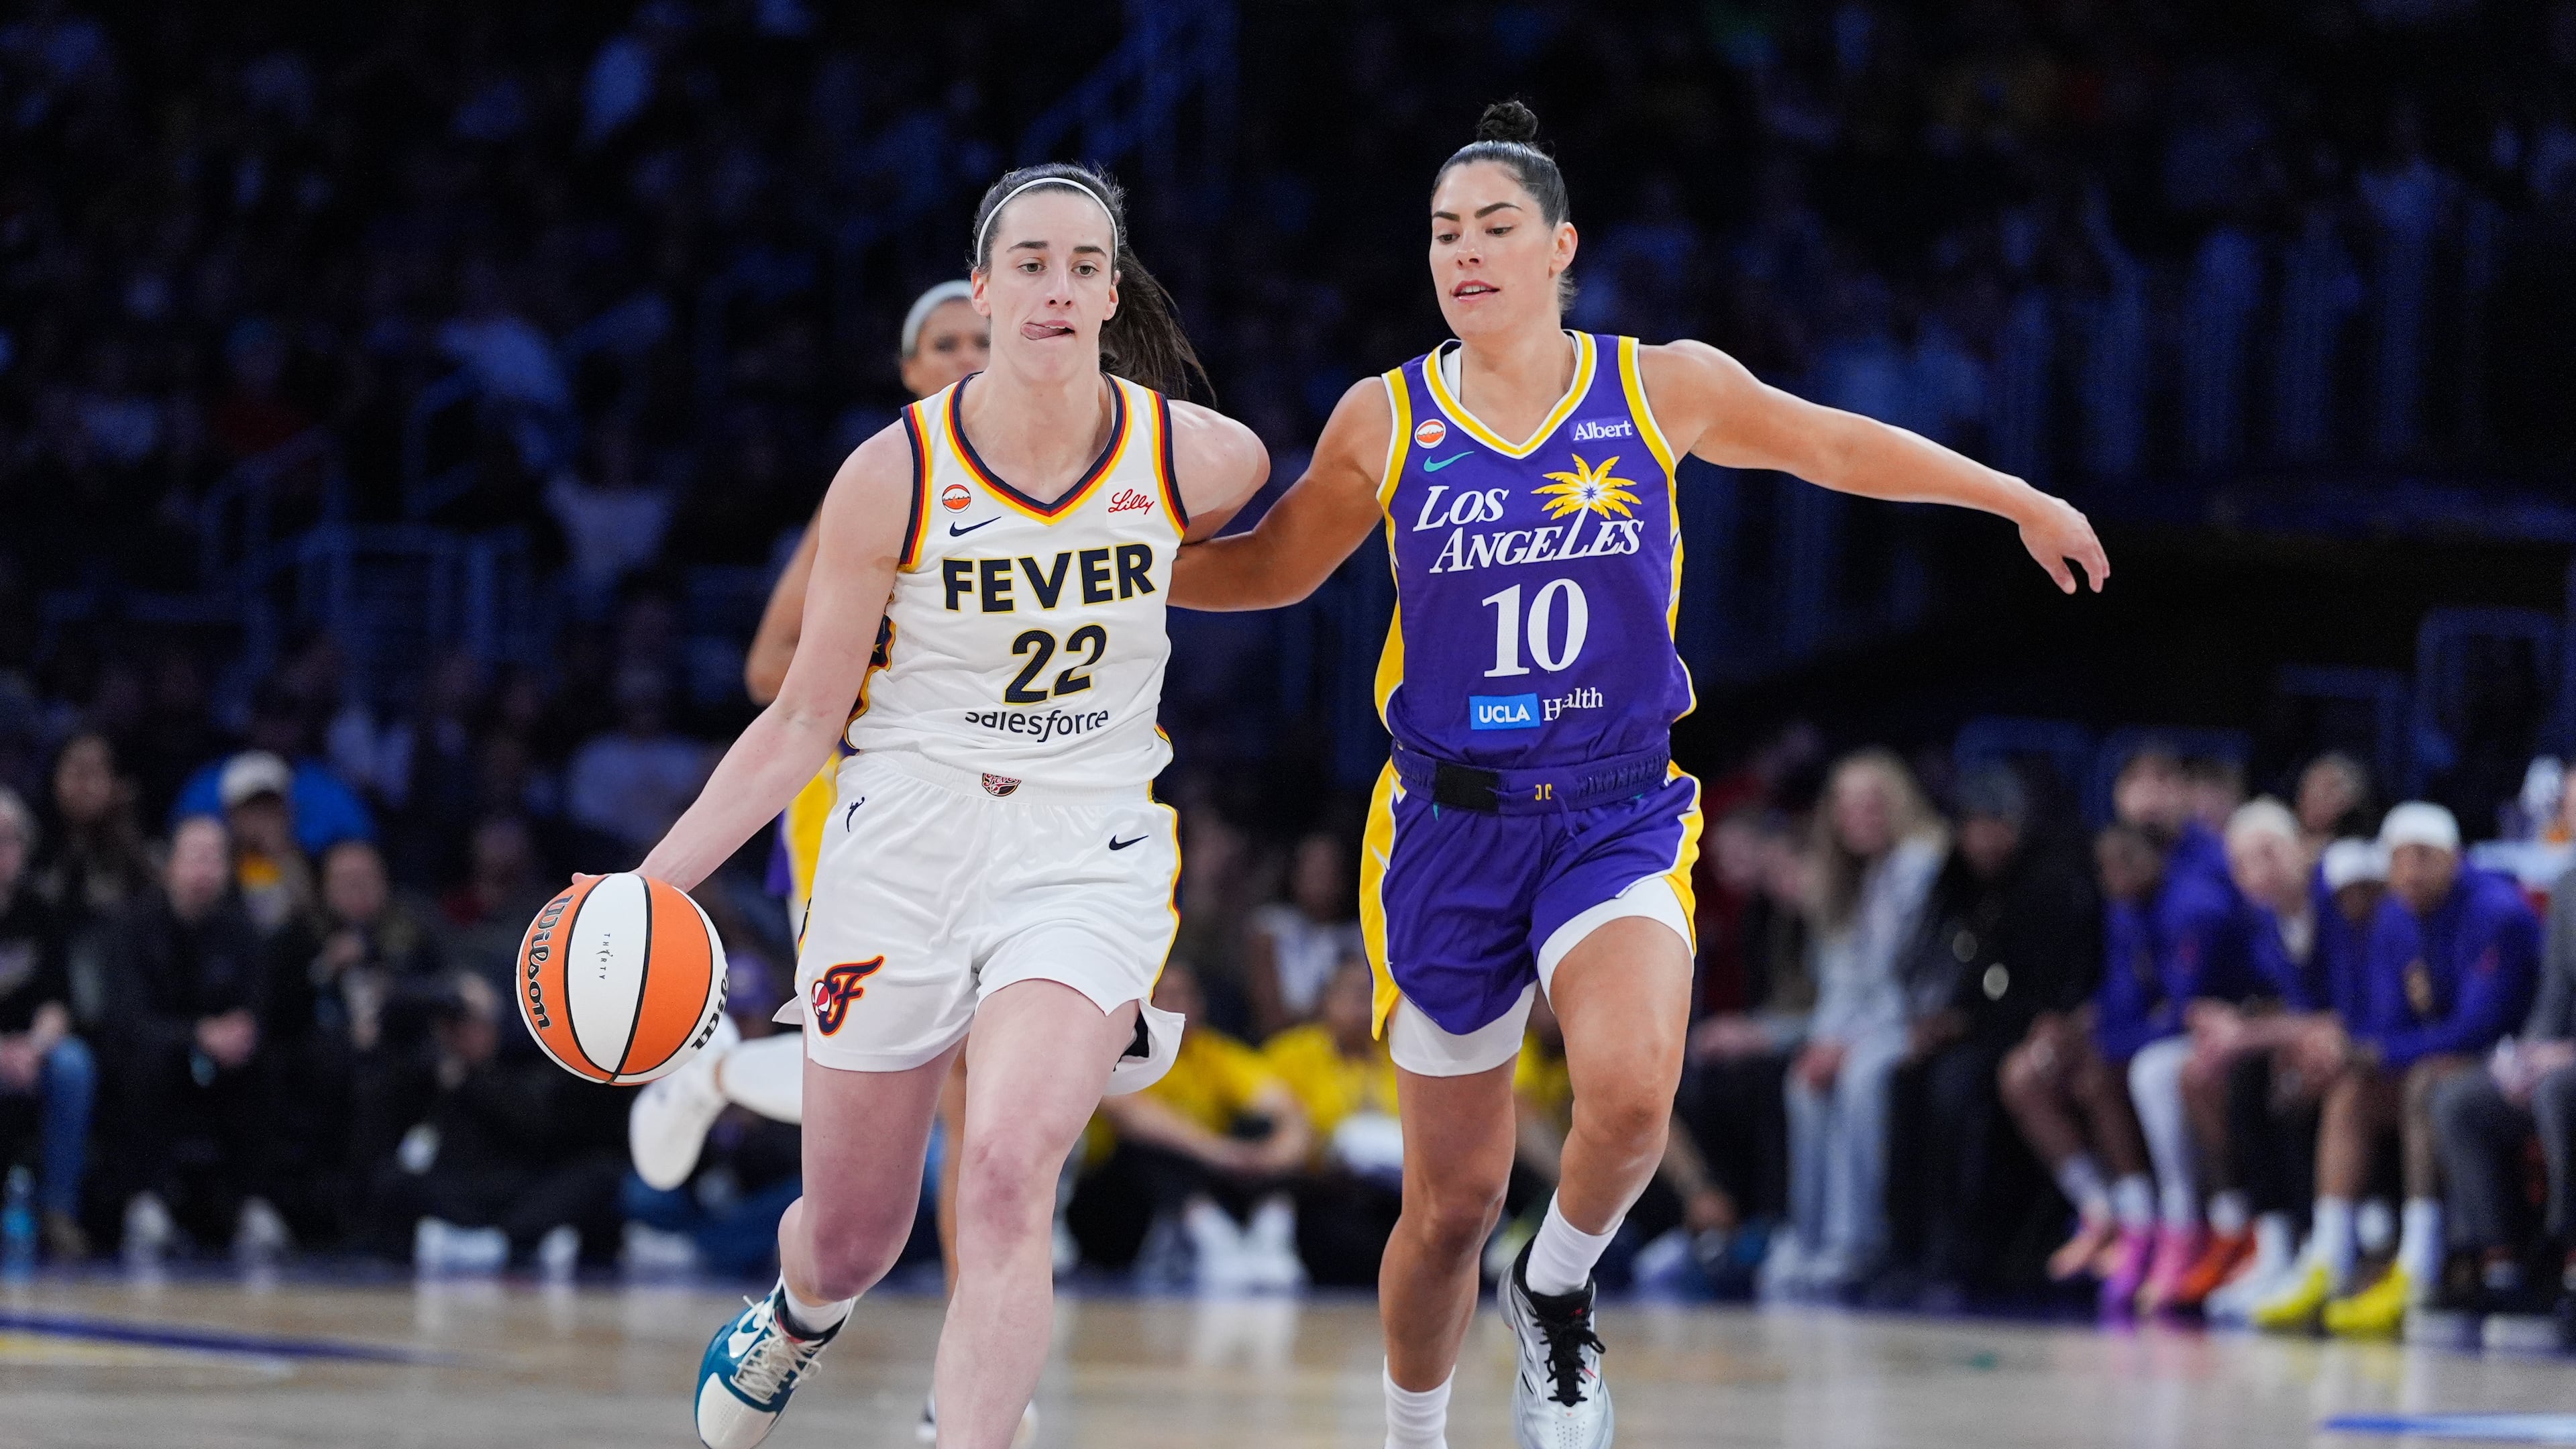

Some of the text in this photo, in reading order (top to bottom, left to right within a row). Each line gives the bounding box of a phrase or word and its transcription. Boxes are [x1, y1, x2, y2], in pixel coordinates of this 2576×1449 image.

[1573, 419, 1633, 441] Albert
[1108, 488, 1155, 515] Lilly
[941, 541, 1156, 614] FEVER
[1004, 622, 1108, 706] 22
[1481, 578, 1589, 678] 10
[1479, 686, 1604, 724] UCLA Halth
[527, 894, 575, 1031] Wilson
[690, 961, 729, 1051] Wil
